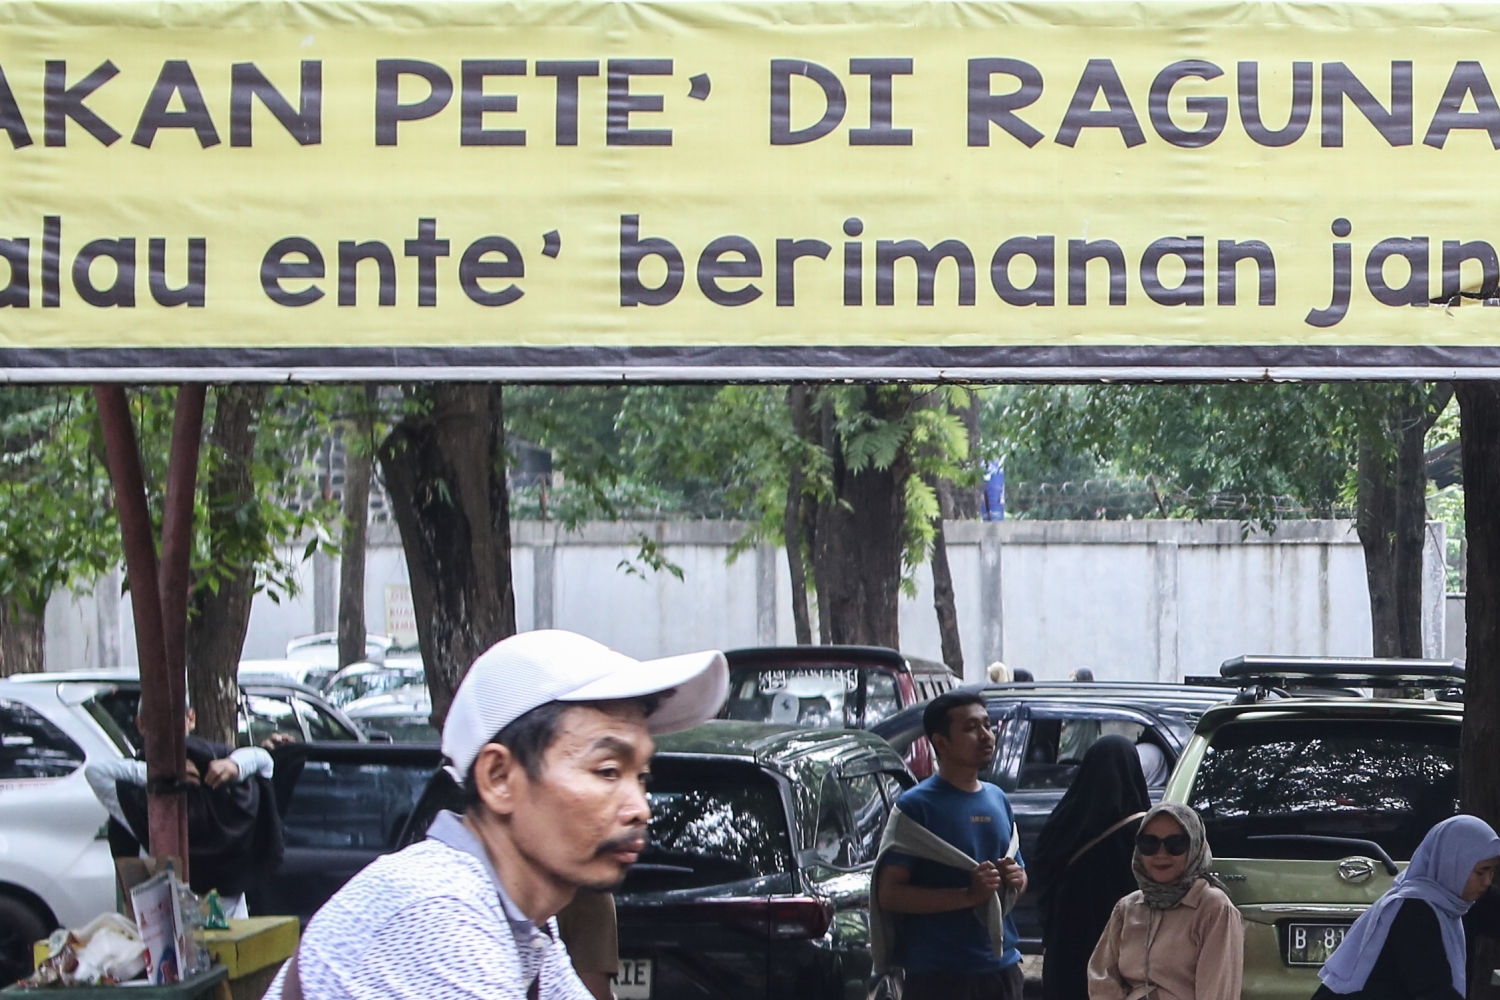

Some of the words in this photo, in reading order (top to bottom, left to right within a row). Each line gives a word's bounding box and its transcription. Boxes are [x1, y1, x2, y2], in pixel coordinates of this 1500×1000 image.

[770, 59, 914, 147] DI
[620, 215, 1276, 308] berimanan
[1295, 927, 1307, 949] B
